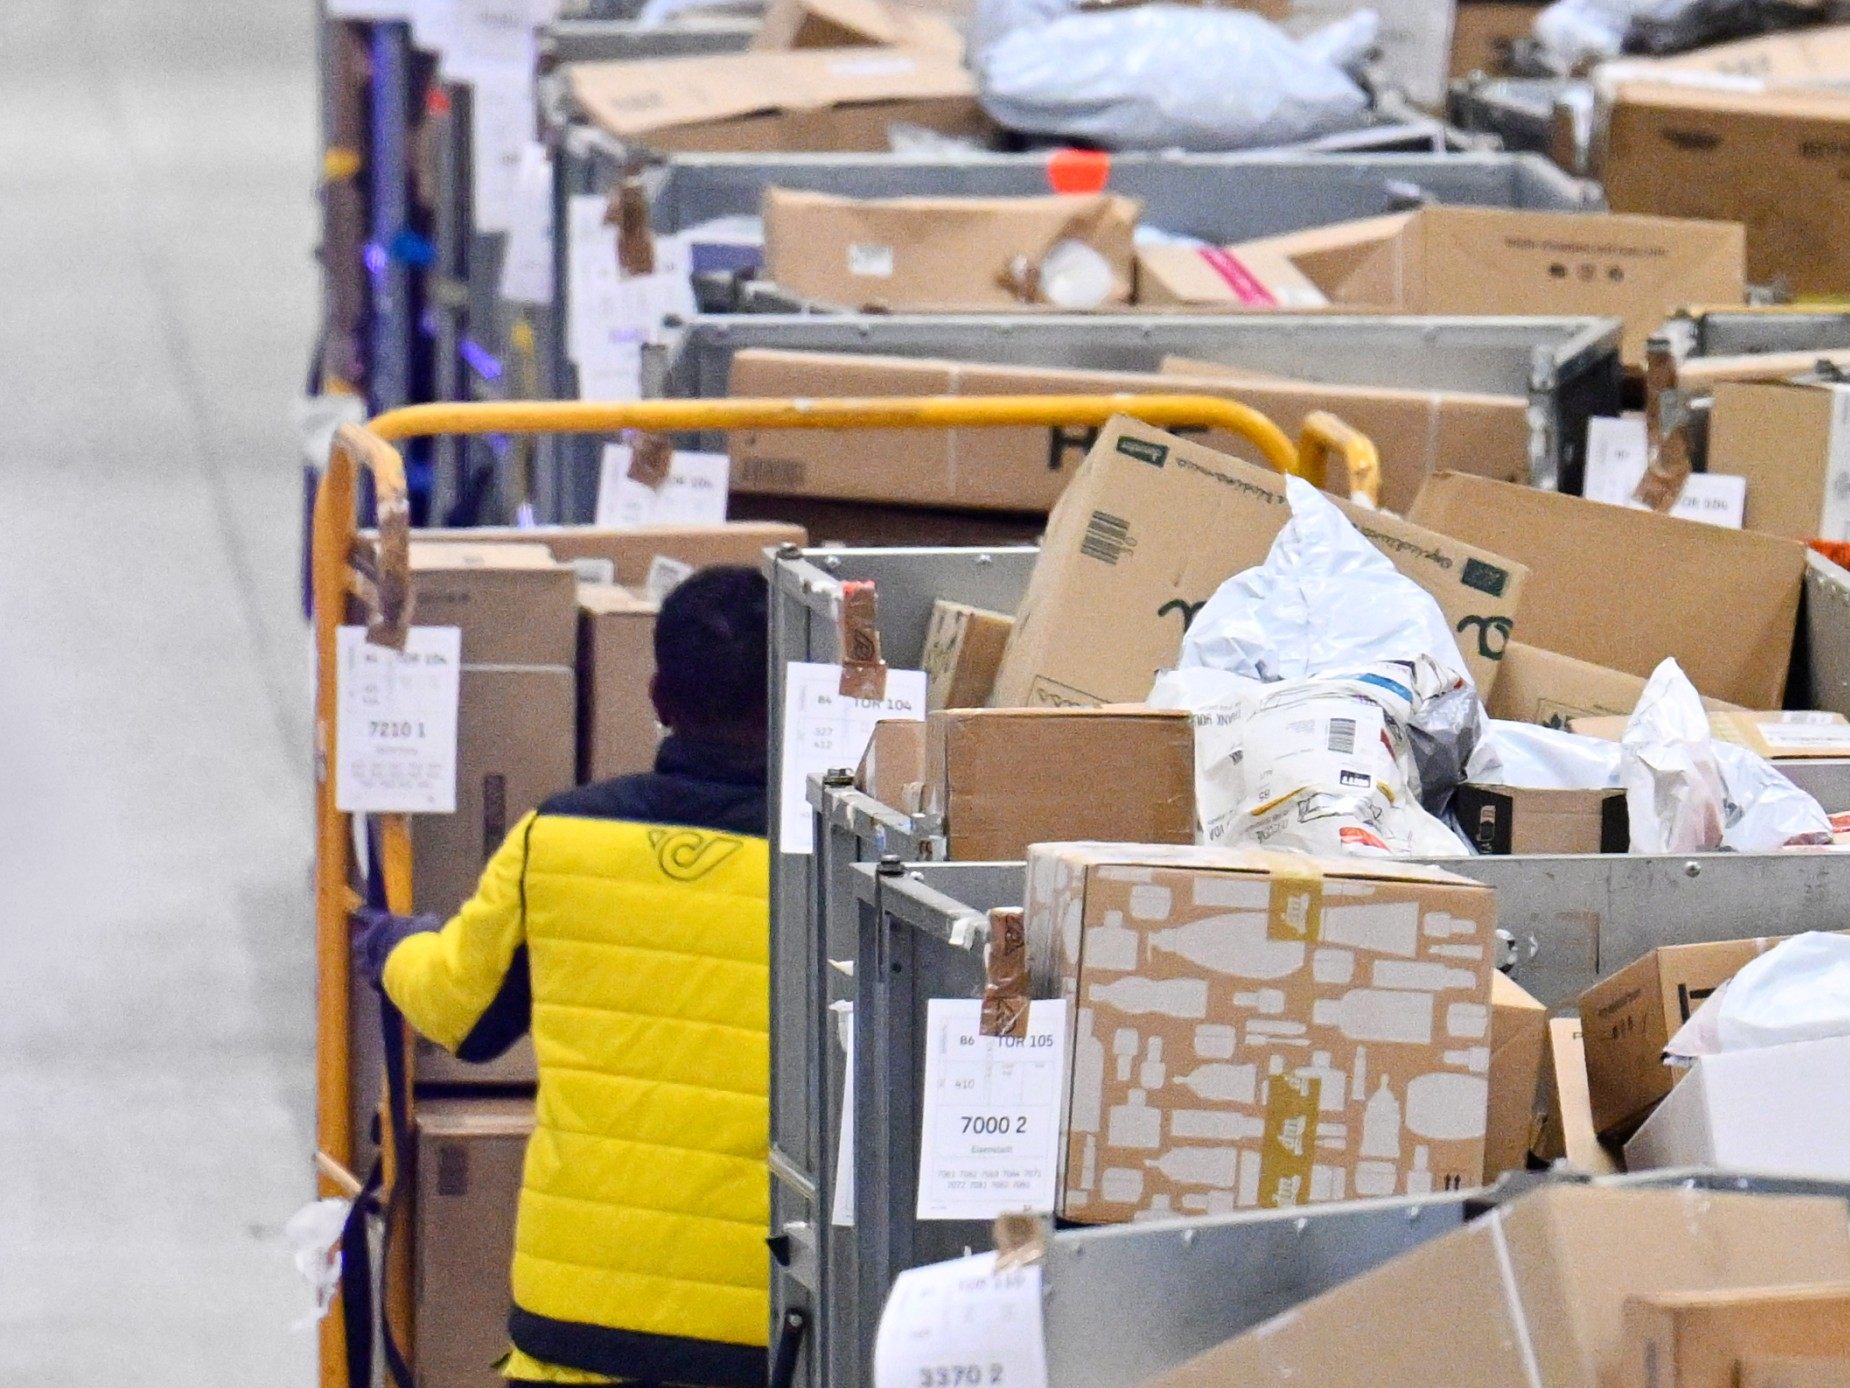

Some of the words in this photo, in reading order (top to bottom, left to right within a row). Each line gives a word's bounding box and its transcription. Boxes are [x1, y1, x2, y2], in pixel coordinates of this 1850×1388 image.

[887, 700, 912, 711] 104
[369, 721, 412, 738] 7210
[959, 1035, 976, 1046] B6
[998, 1035, 1025, 1048] TOR
[1030, 1034, 1055, 1048] 105
[960, 1115, 1011, 1134] 7000
[1016, 1115, 1028, 1134] 2
[919, 1363, 982, 1388] 3370
[989, 1362, 1004, 1385] 2
